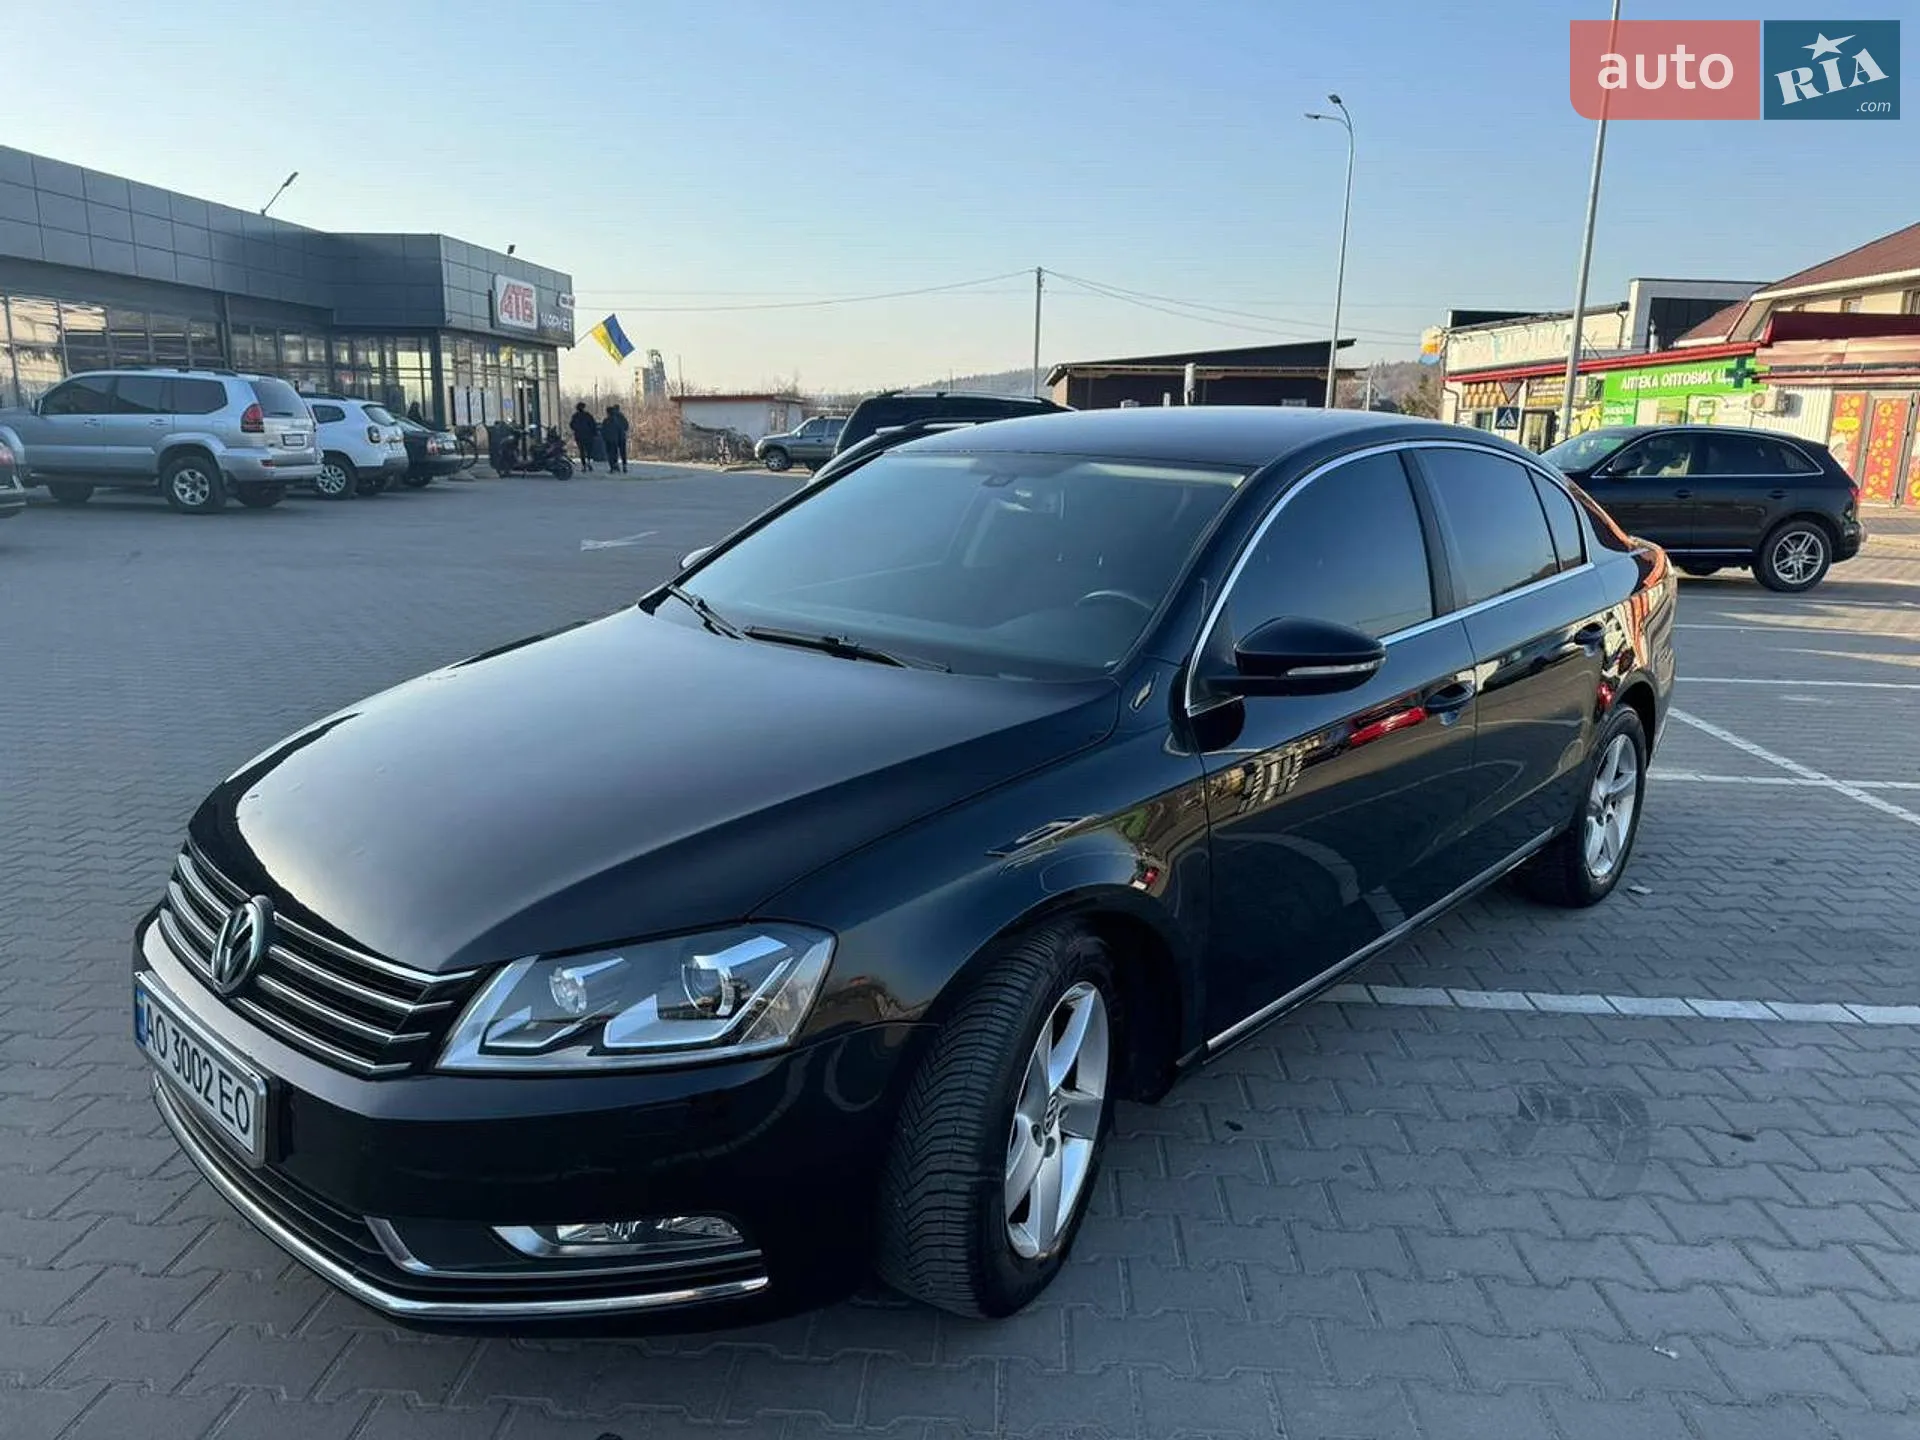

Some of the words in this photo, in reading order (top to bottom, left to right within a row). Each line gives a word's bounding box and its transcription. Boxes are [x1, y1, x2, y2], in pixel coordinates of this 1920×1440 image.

[500, 283, 534, 322] АТБ
[1621, 374, 1660, 391] АПТЕКА
[1661, 367, 1714, 387] ОПТОВИХ
[172, 1026, 215, 1107] 3002
